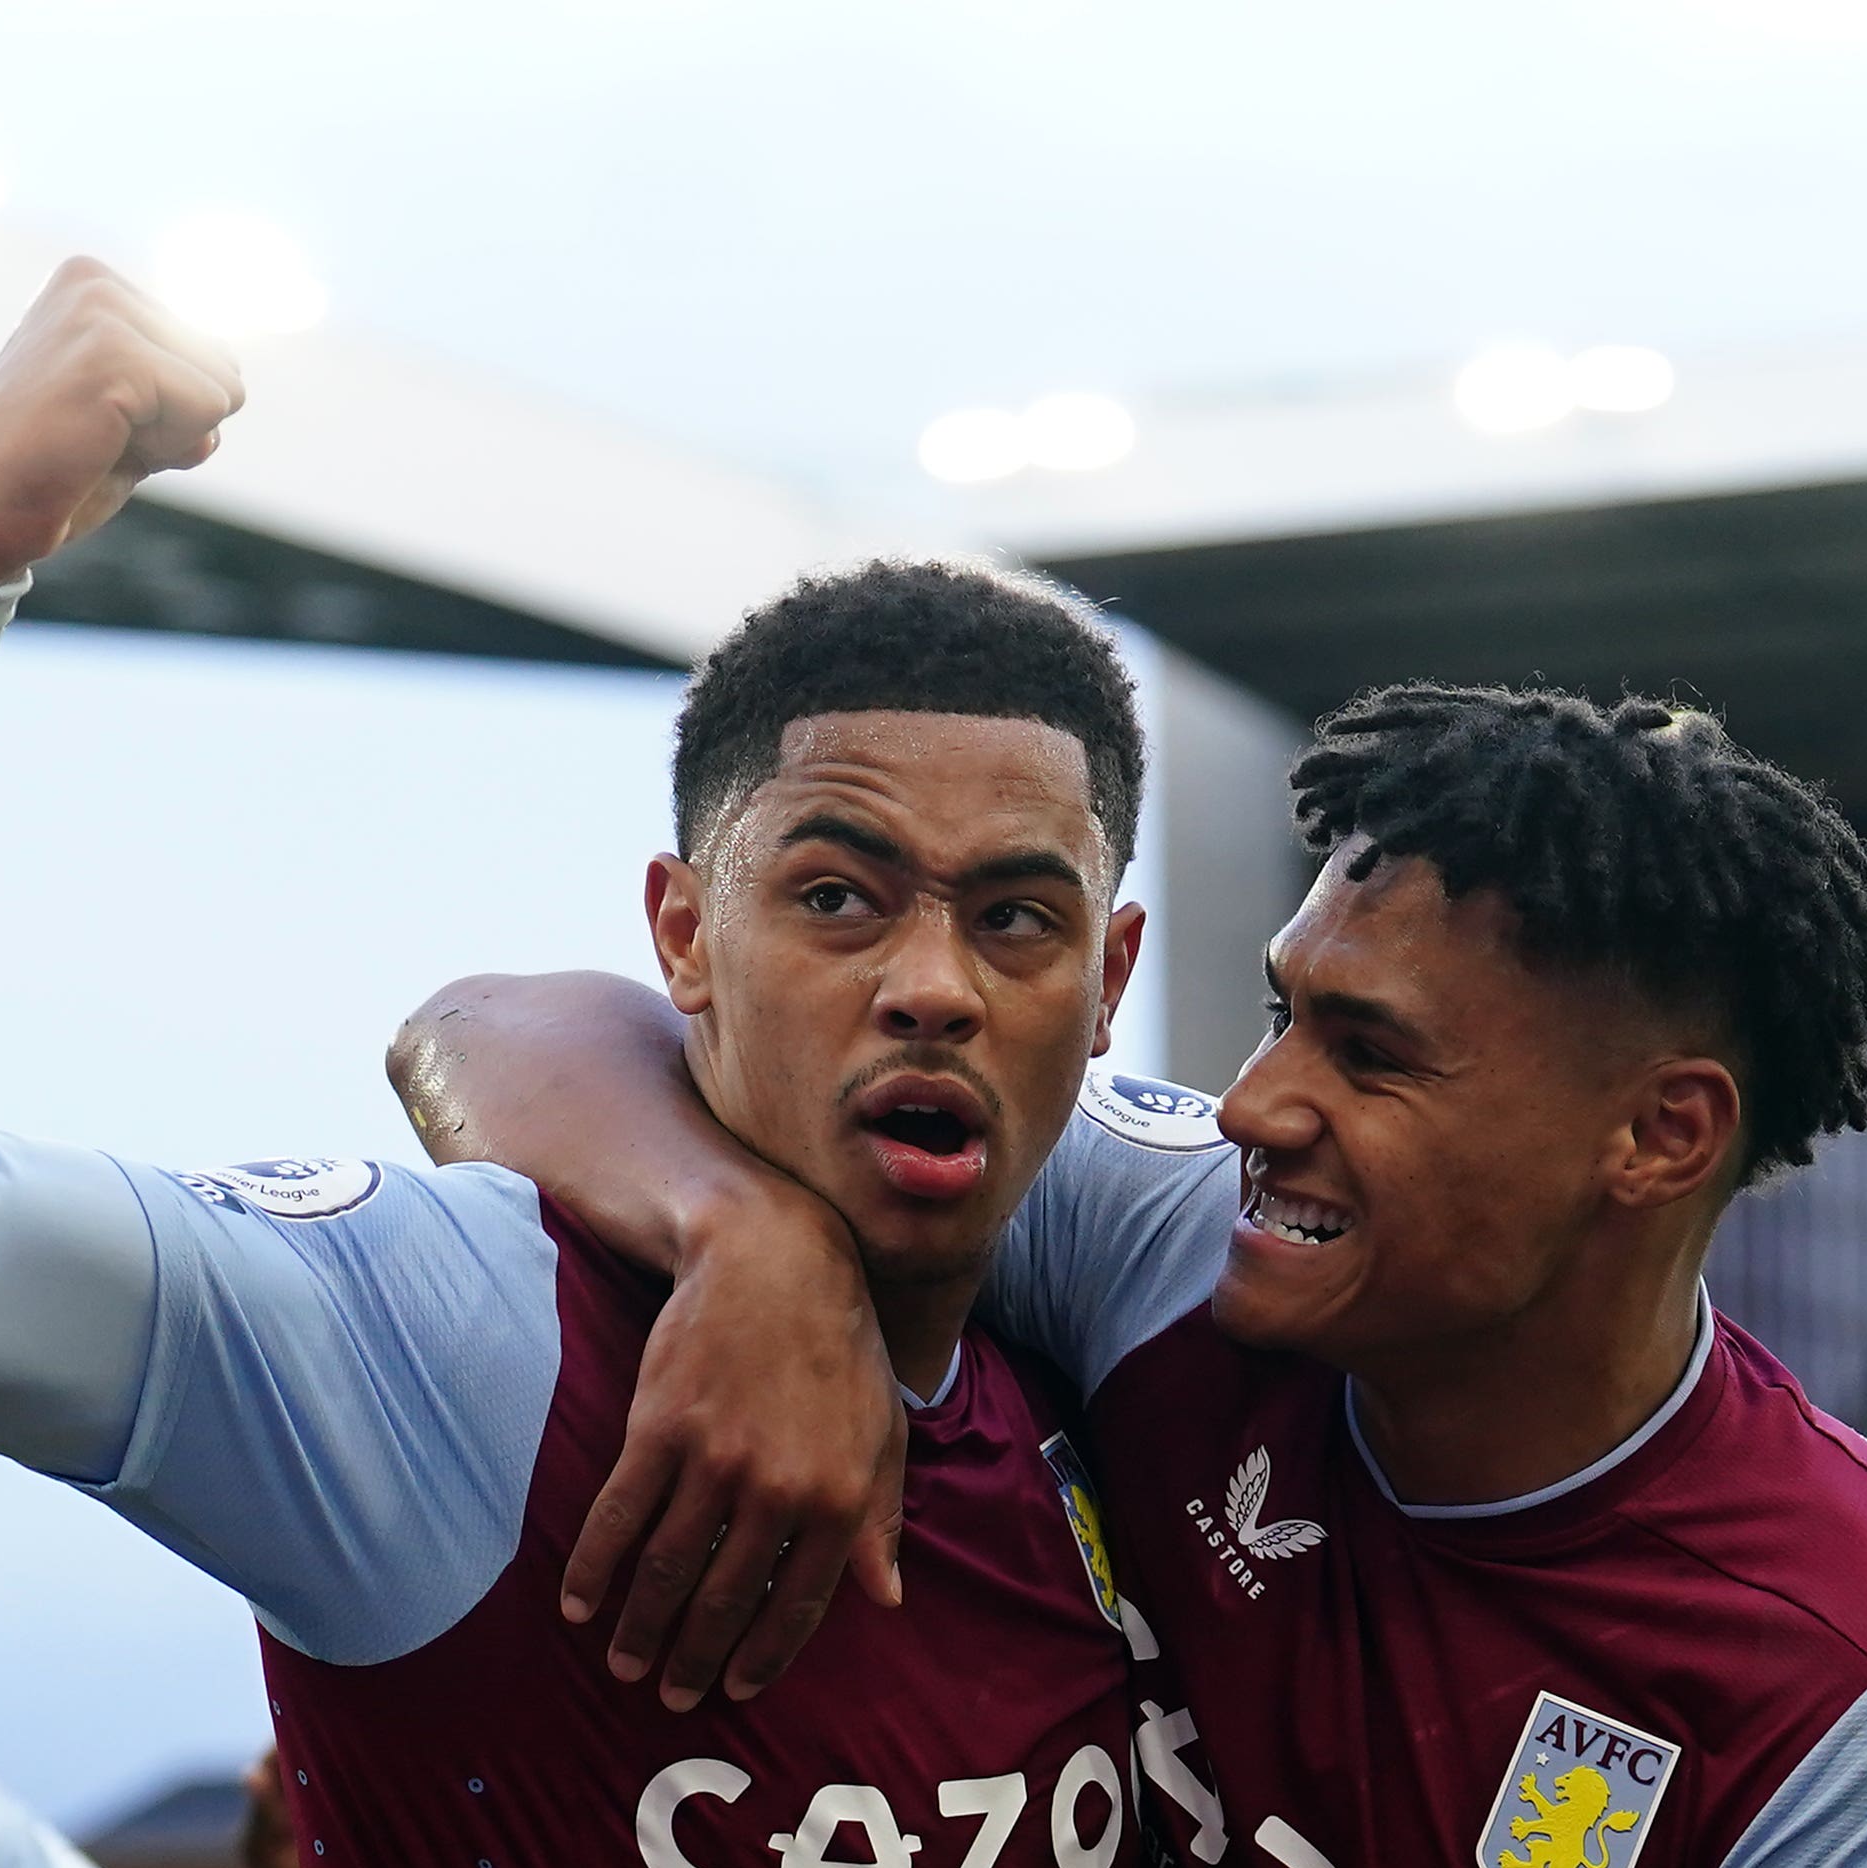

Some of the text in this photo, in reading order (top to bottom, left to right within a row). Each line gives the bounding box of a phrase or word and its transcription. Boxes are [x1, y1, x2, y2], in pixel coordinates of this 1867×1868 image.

[1098, 1098, 1151, 1128] League
[260, 1184, 320, 1202] League
[1186, 1498, 1265, 1600] CASTORE
[1535, 1714, 1664, 1787] AVFC
